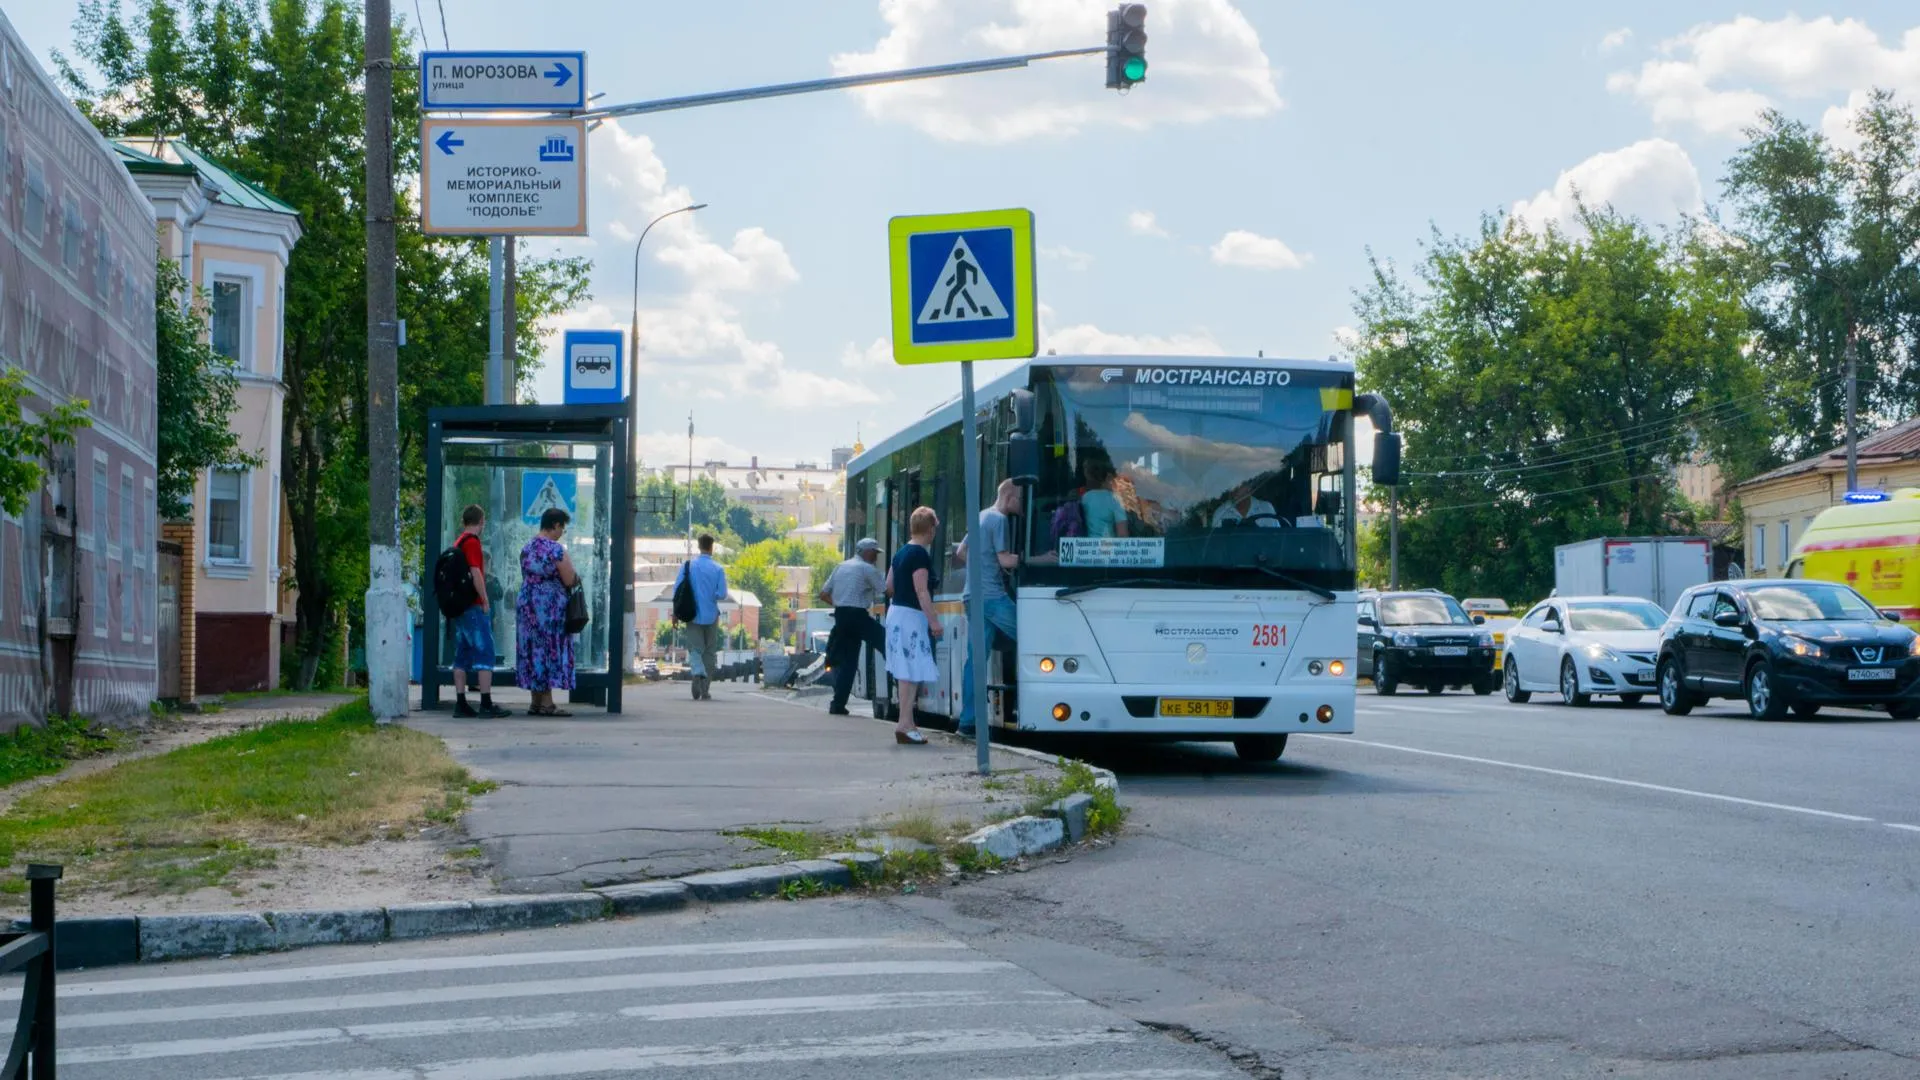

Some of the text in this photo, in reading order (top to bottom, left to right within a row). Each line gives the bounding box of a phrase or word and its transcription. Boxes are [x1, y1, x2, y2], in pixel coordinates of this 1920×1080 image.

[432, 65, 538, 79] П. МОРОЗОВА
[432, 82, 464, 91] улица
[467, 166, 542, 177] ИСТОРИКО-
[447, 178, 561, 190] МЕМОРИАЛЬНЫЙ
[469, 193, 540, 204] КОМПЛЕКС
[1135, 368, 1291, 386] МОСТРАНСАВТО
[1061, 542, 1074, 562] 520
[1252, 624, 1287, 646] 2581
[1167, 702, 1229, 714] КЕ 581 50
